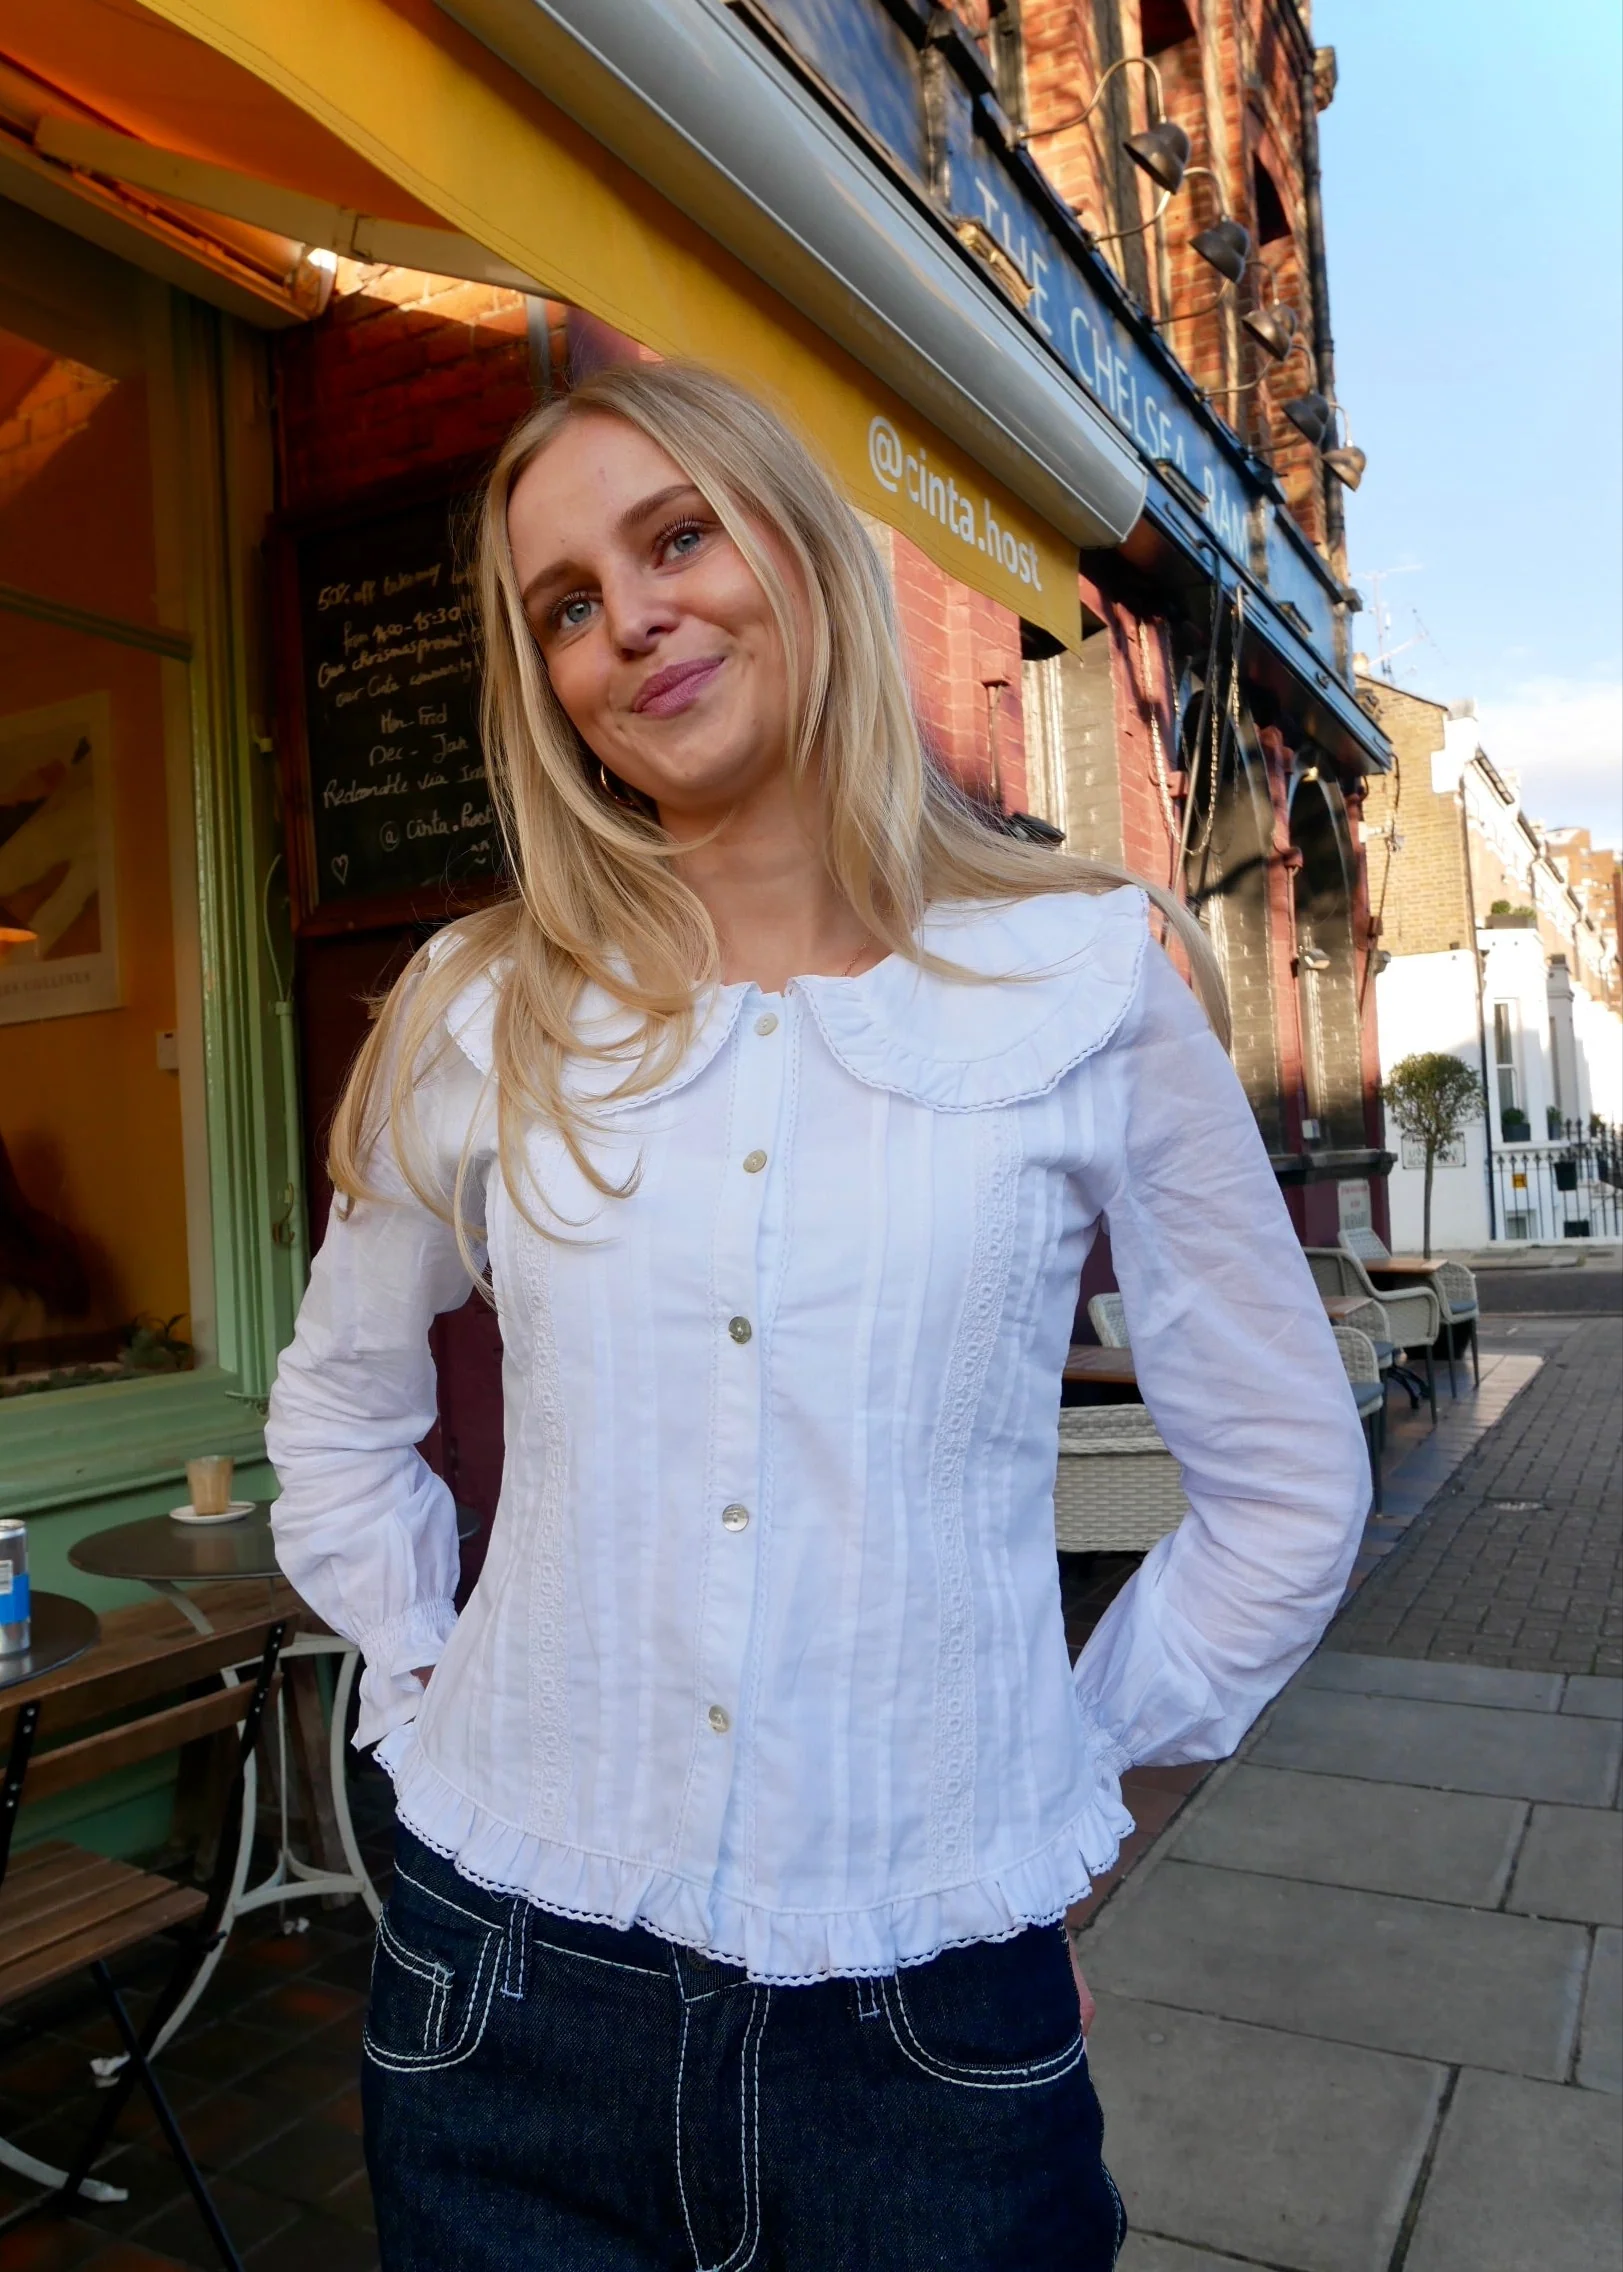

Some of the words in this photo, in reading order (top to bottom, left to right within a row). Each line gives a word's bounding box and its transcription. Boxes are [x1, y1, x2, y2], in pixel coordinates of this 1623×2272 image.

[868, 415, 1043, 592] @cinta.host
[974, 175, 1053, 337] THE
[1070, 306, 1188, 475] CHELSEA
[1203, 465, 1251, 570] RAM
